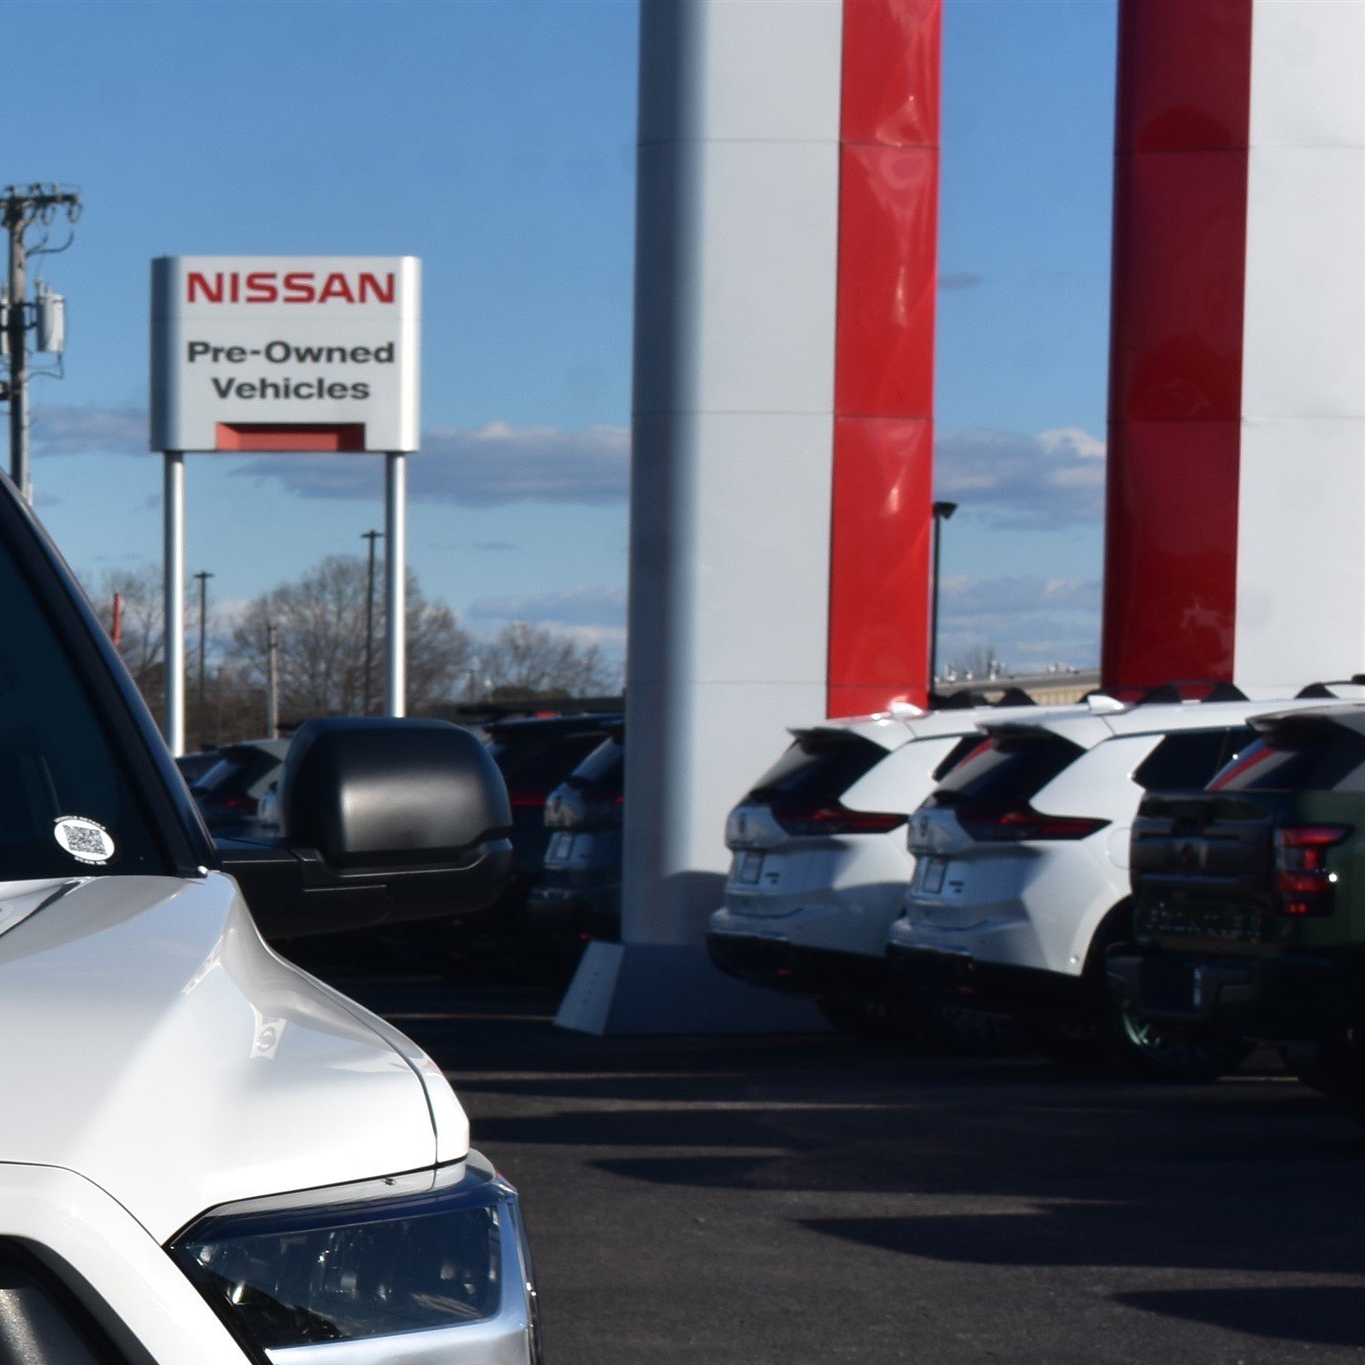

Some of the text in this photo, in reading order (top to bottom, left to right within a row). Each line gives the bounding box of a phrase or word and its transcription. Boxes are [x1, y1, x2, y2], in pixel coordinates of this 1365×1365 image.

[187, 271, 395, 304] NISSAN
[187, 340, 395, 364] Pre-Owned
[211, 377, 371, 400] Vehicles
